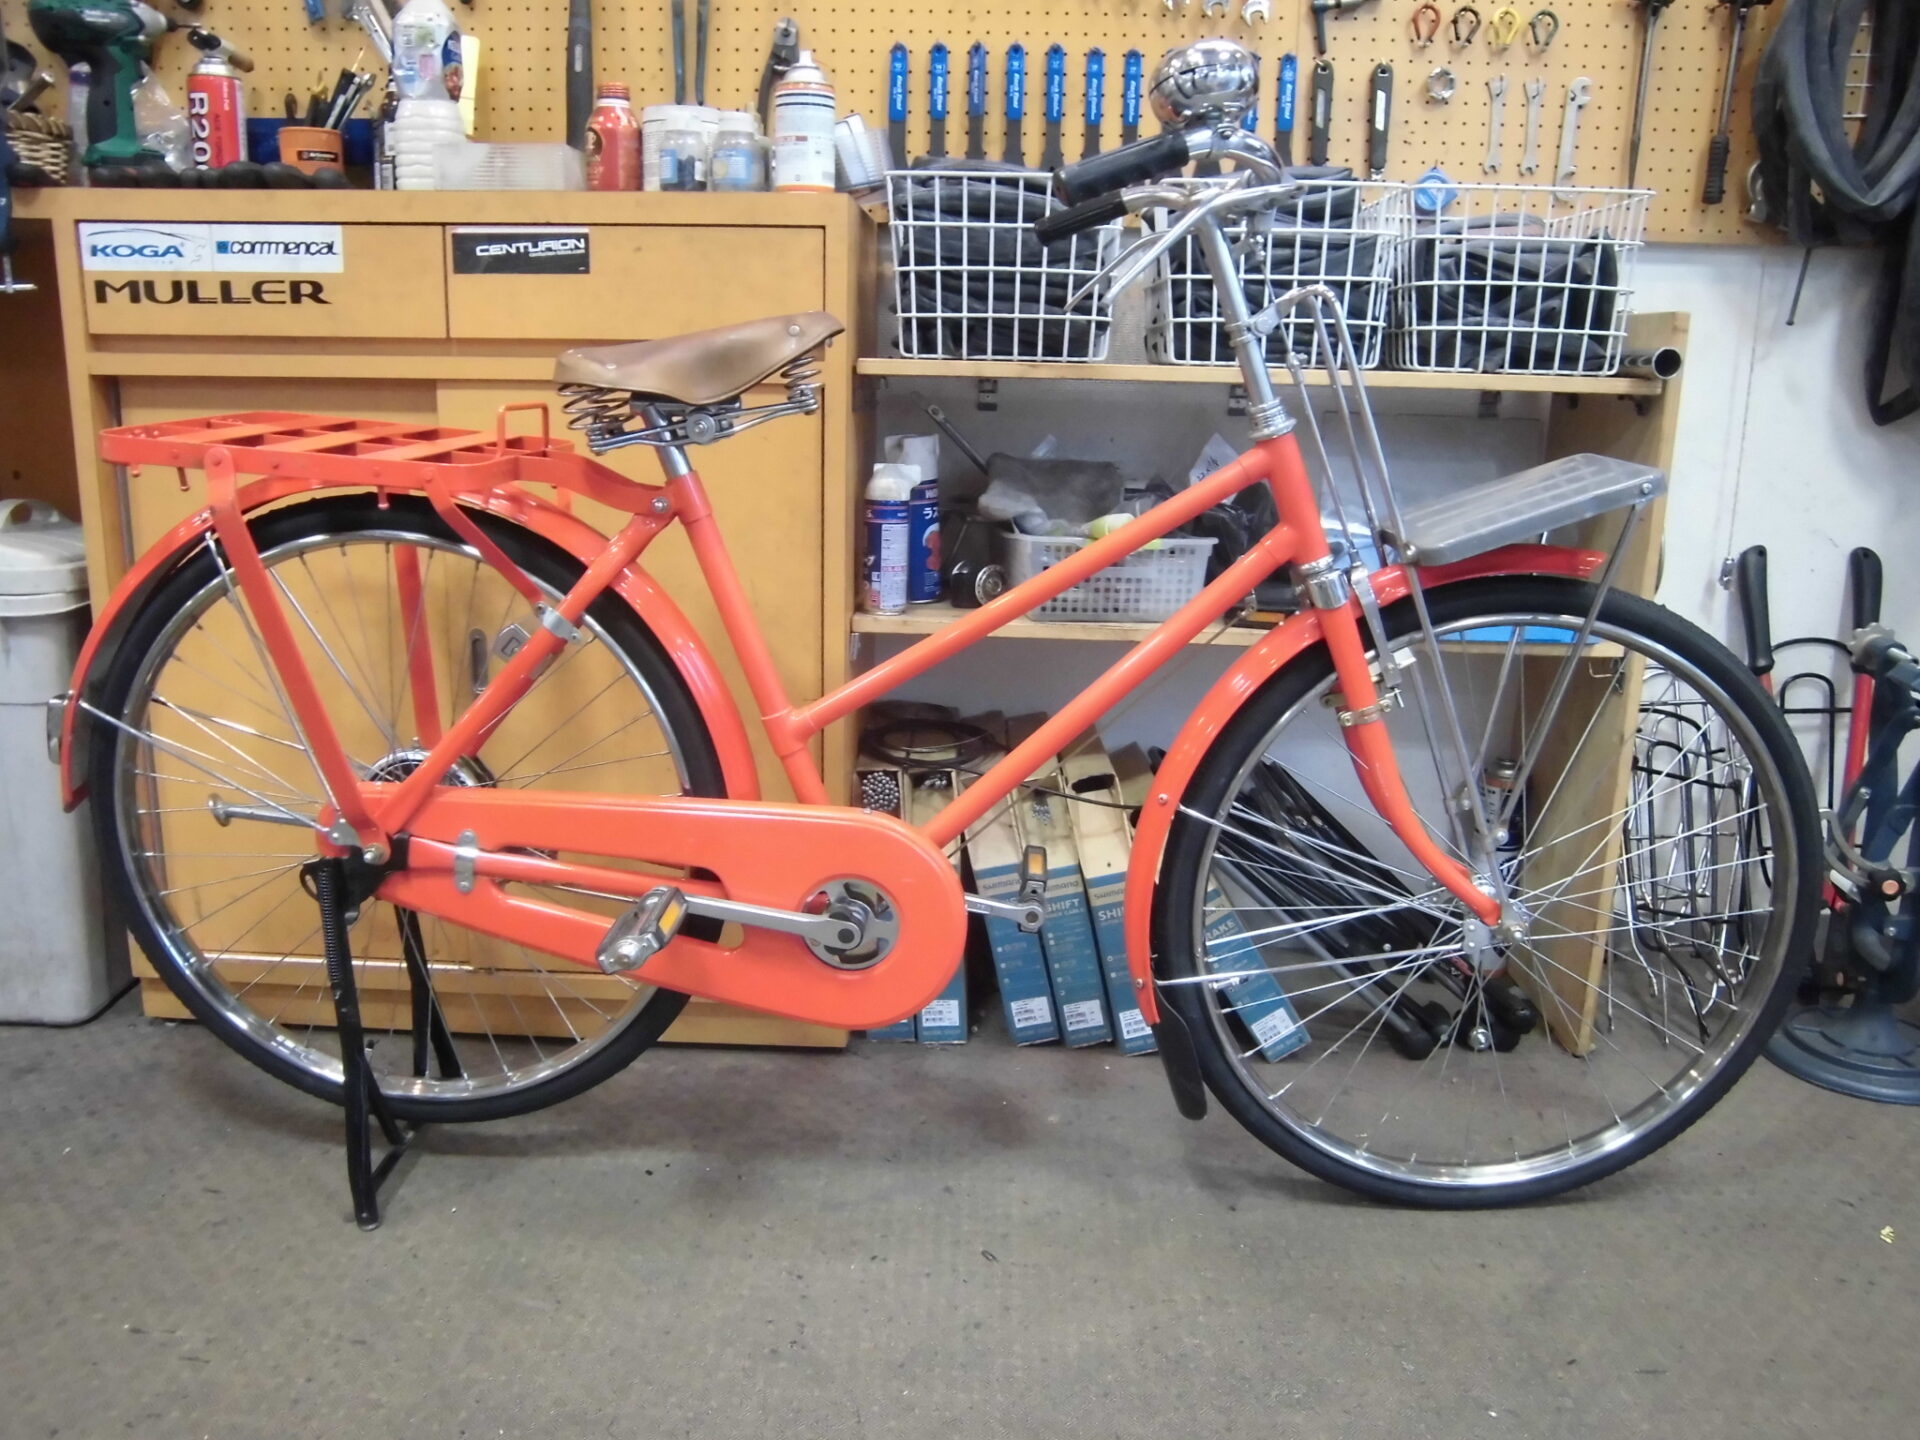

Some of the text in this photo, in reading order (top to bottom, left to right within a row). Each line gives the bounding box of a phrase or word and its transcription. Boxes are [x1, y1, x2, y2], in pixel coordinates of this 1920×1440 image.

[189, 91, 212, 171] R20
[90, 244, 184, 258] KOGA
[475, 238, 586, 256] CENTURION
[94, 279, 332, 304] MULLER
[1098, 906, 1124, 920] SHI
[1205, 918, 1236, 940] RAKE
